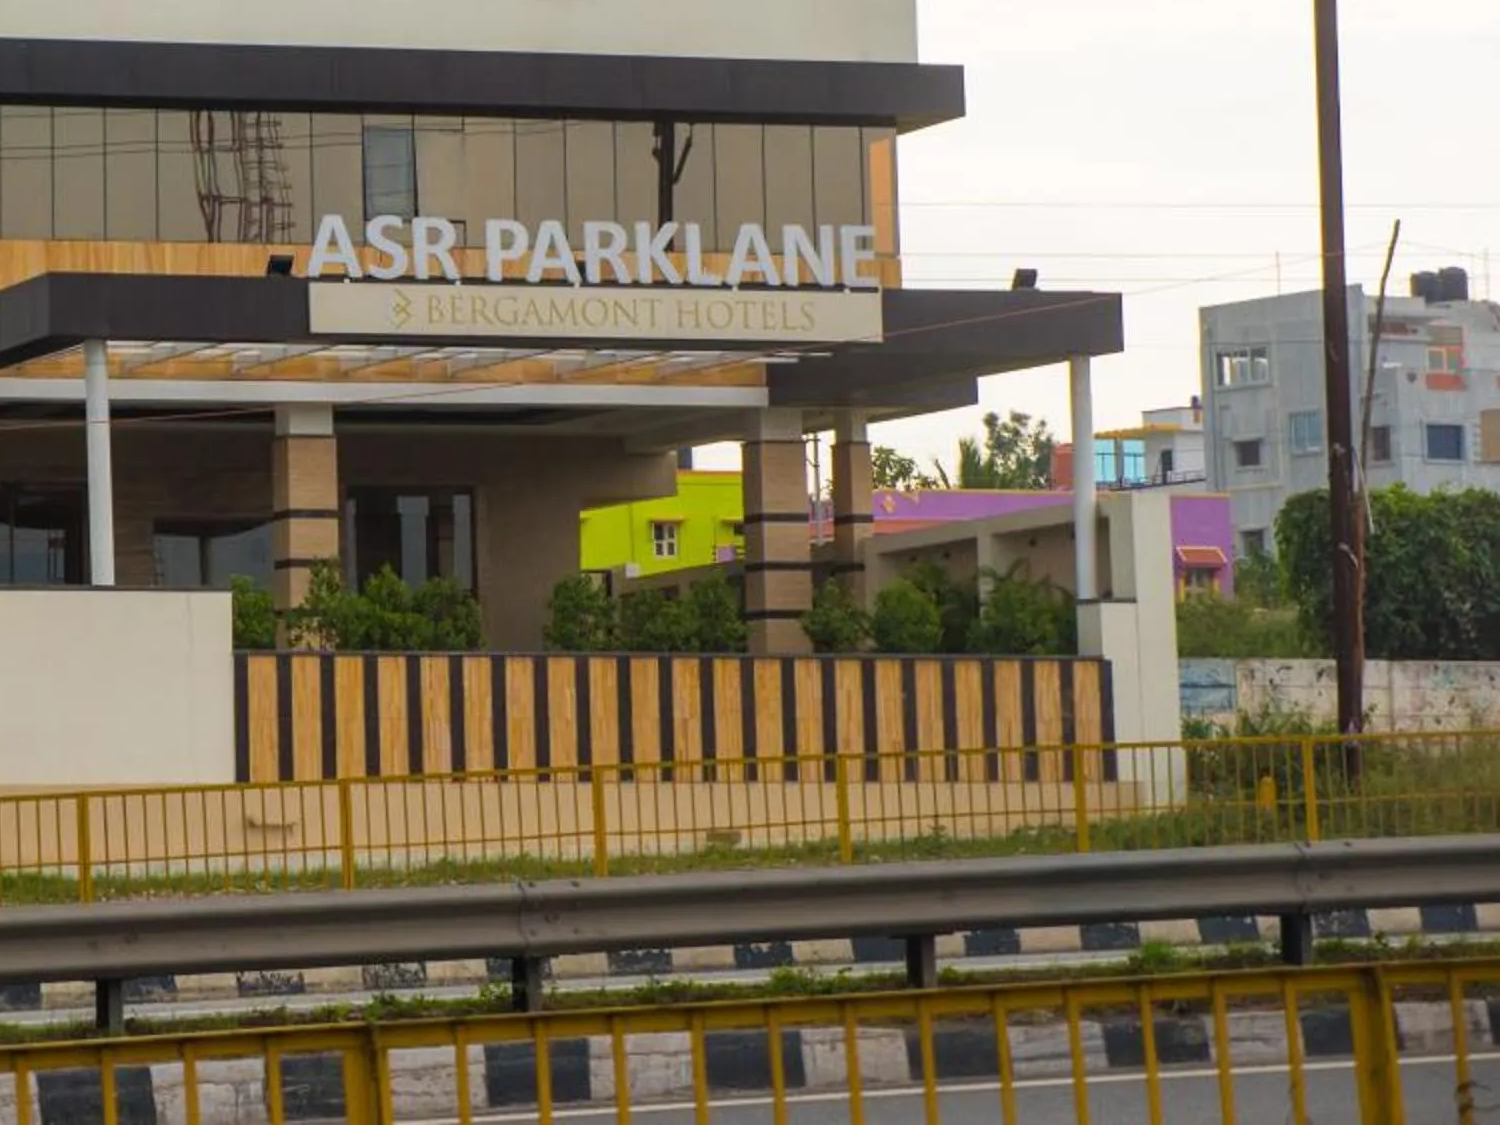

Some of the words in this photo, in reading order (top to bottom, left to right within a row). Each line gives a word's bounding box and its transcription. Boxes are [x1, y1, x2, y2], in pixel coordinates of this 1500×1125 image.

[307, 213, 462, 280] ASR
[485, 218, 879, 287] PARKLANE
[426, 292, 662, 329] BERGAMONT
[676, 298, 816, 332] HOTELS
